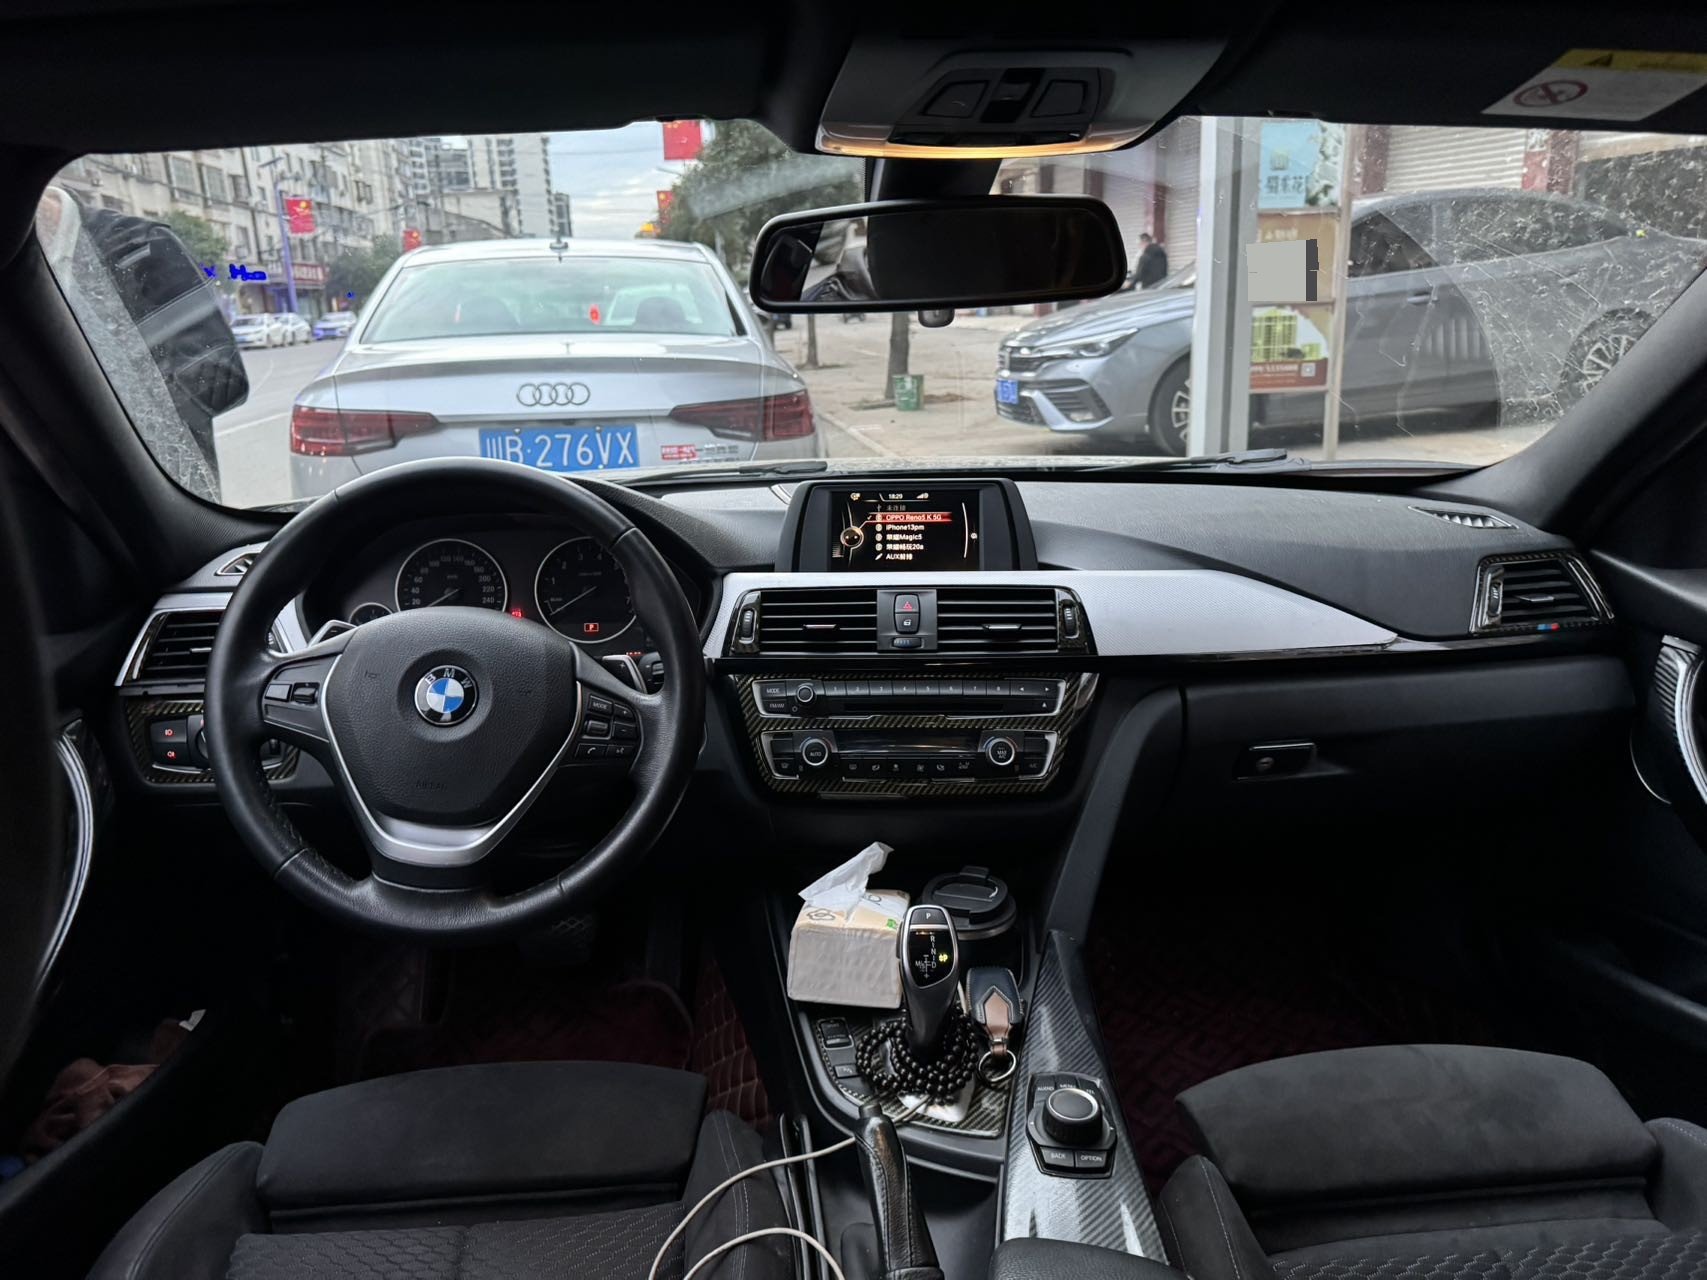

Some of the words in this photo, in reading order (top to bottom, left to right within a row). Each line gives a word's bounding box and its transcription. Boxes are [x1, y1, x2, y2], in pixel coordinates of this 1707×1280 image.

[886, 524, 925, 532] iPhone13pm
[425, 668, 473, 689] BMW
[592, 701, 608, 710] MODE
[926, 912, 931, 920] P
[1080, 1154, 1102, 1162] OPTION
